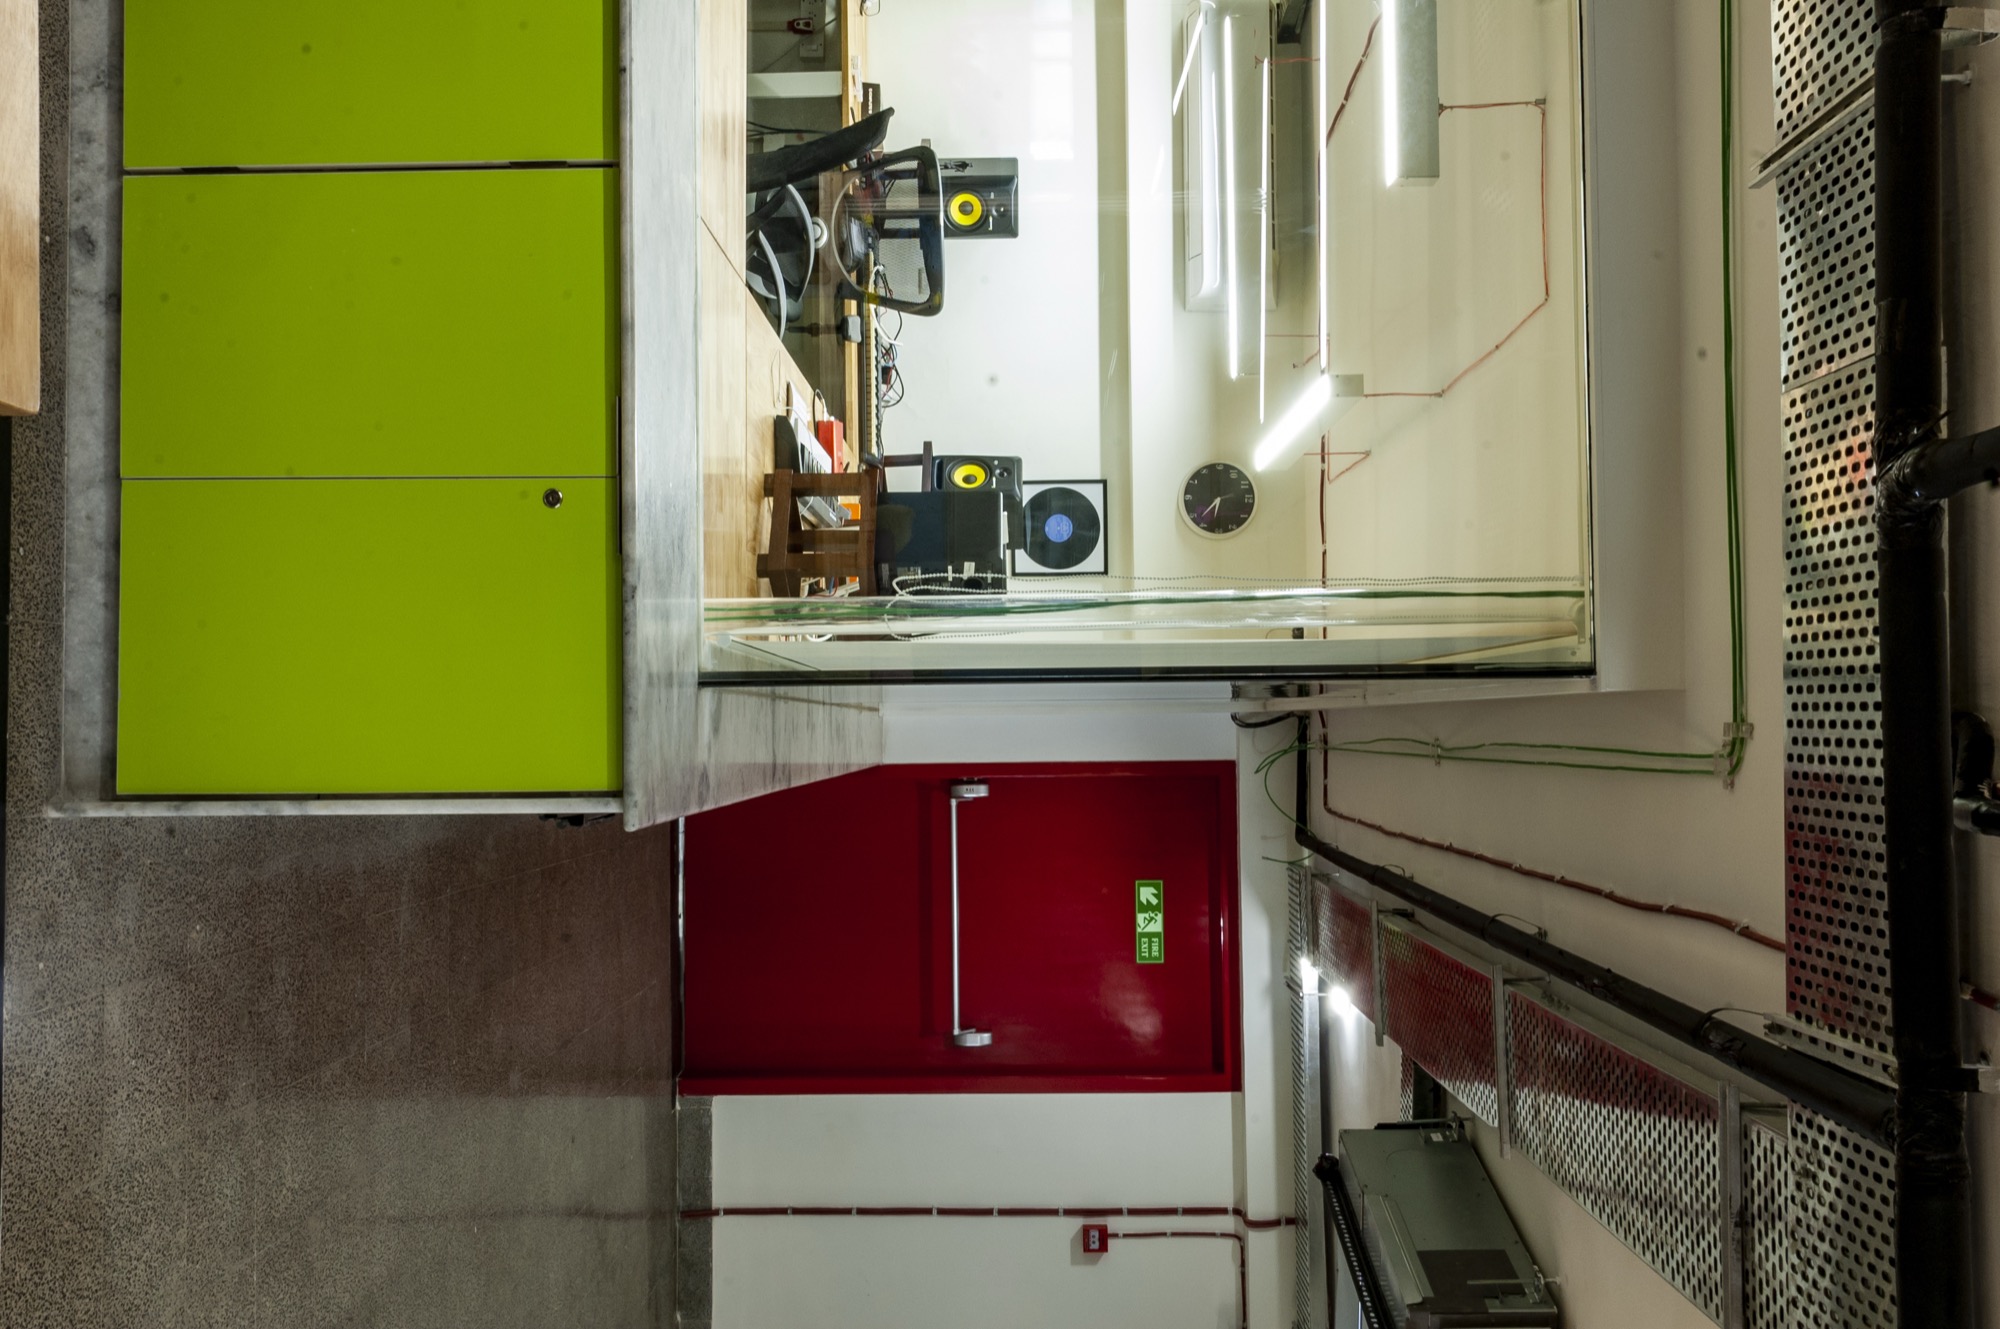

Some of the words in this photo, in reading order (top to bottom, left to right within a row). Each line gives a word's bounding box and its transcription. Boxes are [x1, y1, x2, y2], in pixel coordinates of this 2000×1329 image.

[1230, 470, 1238, 479] 10
[1241, 481, 1249, 489] 11
[1245, 494, 1253, 503] 12
